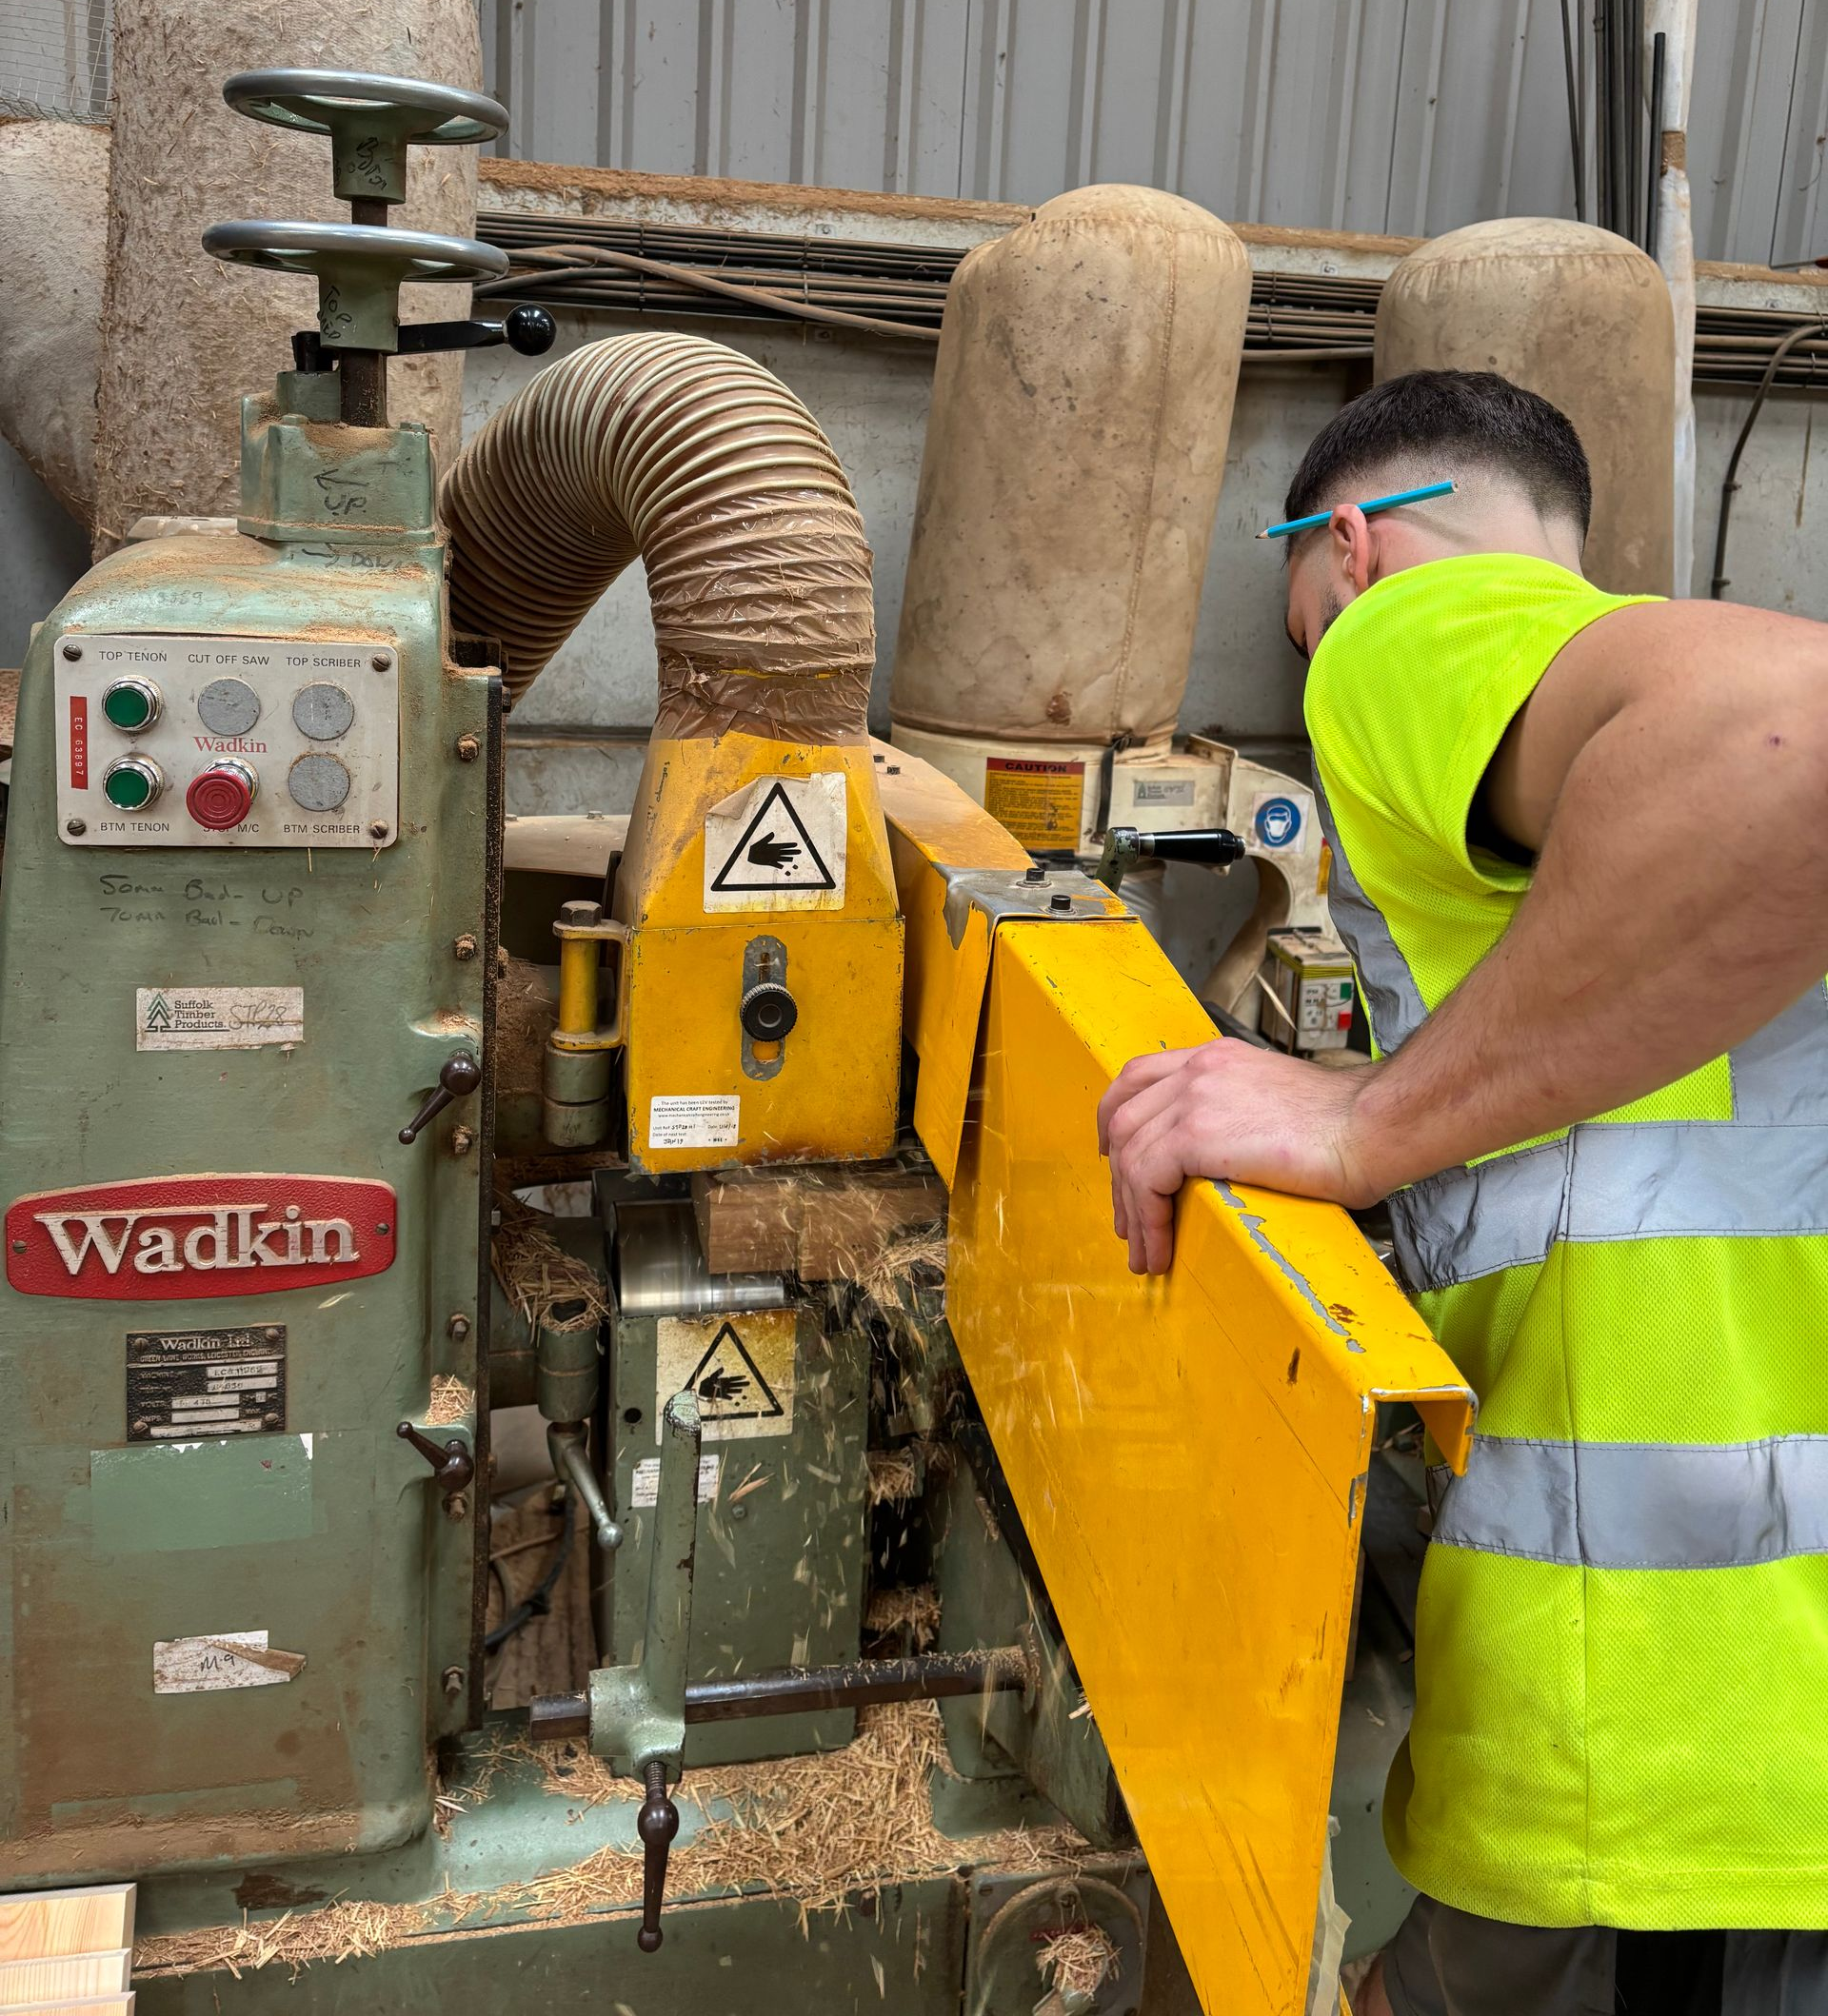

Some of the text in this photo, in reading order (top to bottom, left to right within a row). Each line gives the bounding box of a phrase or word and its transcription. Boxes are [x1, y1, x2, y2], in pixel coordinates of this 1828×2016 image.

[99, 651, 168, 662] TOP TENON
[188, 654, 270, 665] CUT OFF SAW
[286, 657, 361, 668] TOP SCRIBER
[74, 717, 85, 775] EC 63897
[193, 736, 268, 754] Wadkin
[1004, 762, 1067, 773] CAUTION
[100, 822, 169, 833] BTM TENON
[237, 823, 260, 833] M/C
[284, 824, 360, 834] BTM SCRIBER
[174, 1000, 214, 1009] Suffolk
[174, 1010, 216, 1019] Timber
[174, 1019, 227, 1029] Products.
[33, 1203, 360, 1275] Wadkin
[159, 1335, 221, 1351] Wadkin
